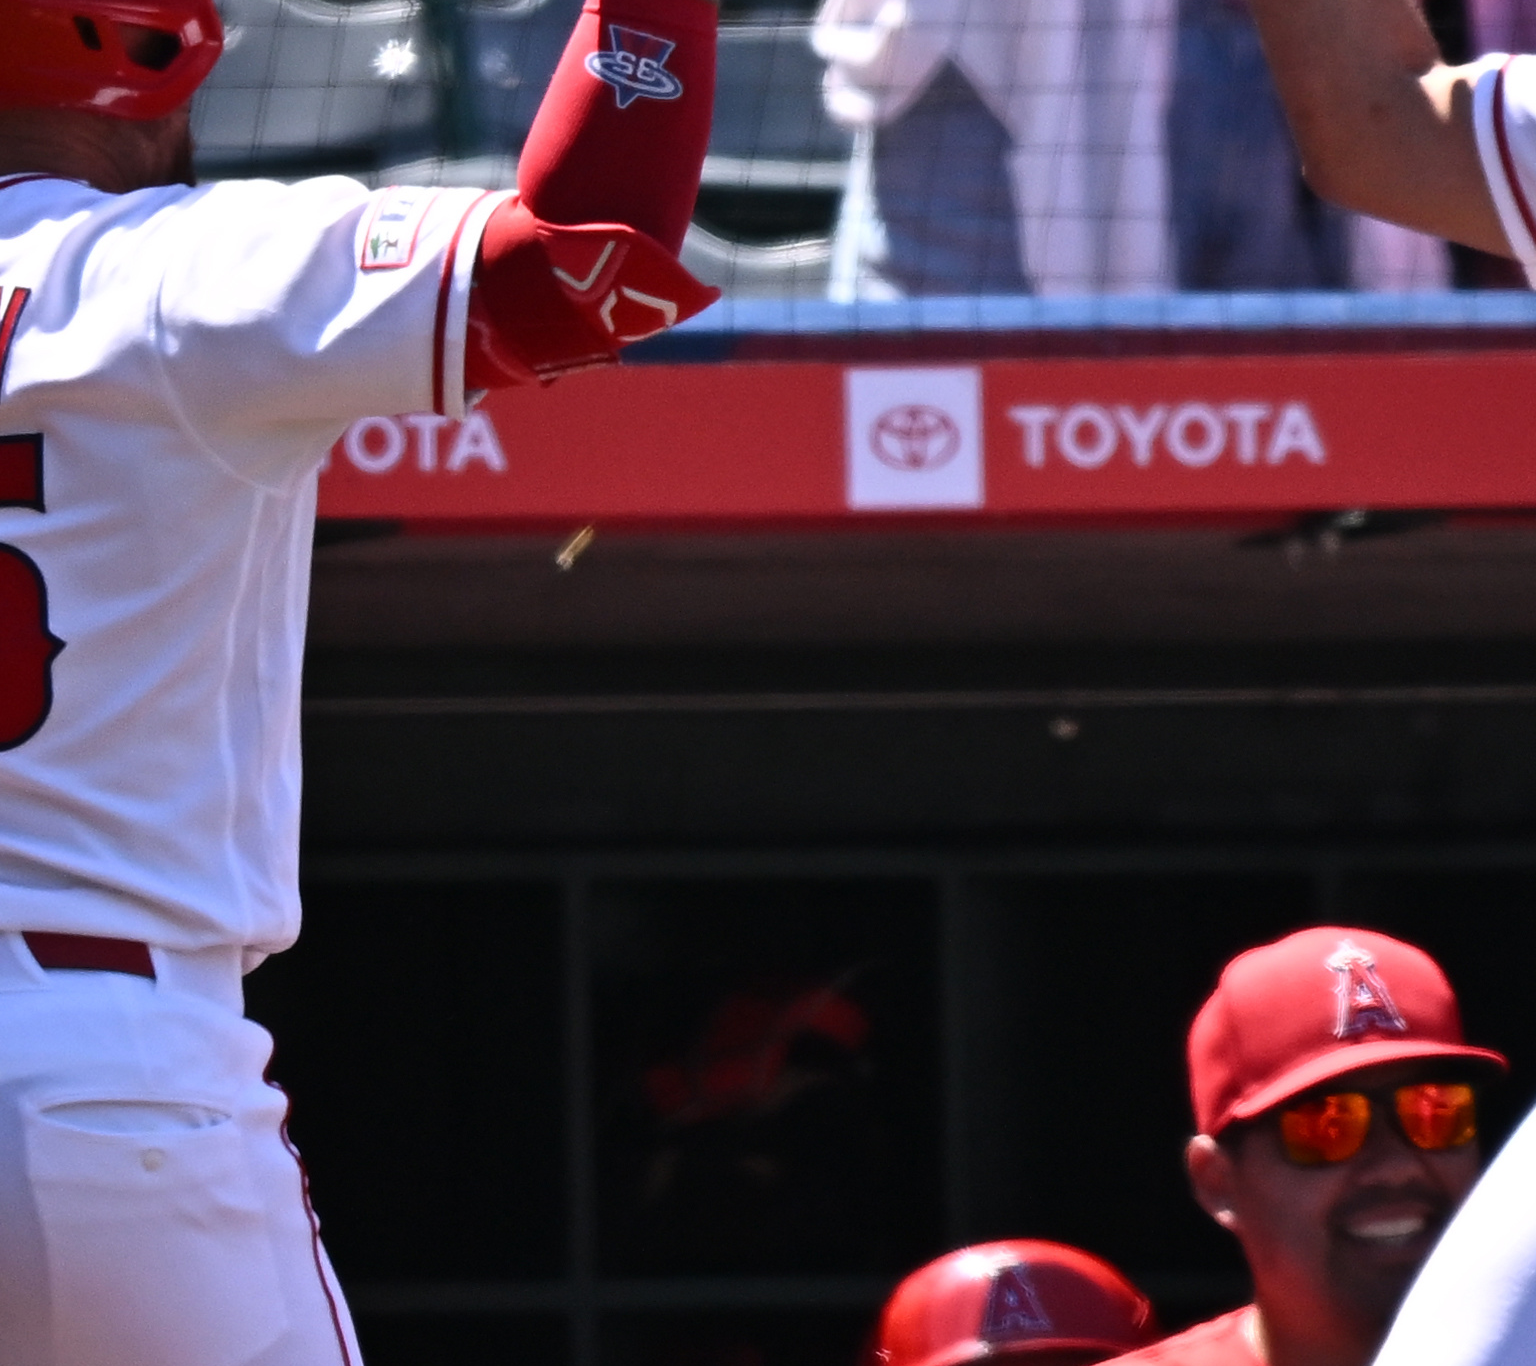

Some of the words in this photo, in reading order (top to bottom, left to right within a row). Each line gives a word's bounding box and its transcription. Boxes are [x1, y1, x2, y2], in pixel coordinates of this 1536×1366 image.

[342, 411, 508, 473] OTA
[1007, 403, 1322, 467] TOYOTA
[1324, 938, 1408, 1039] A
